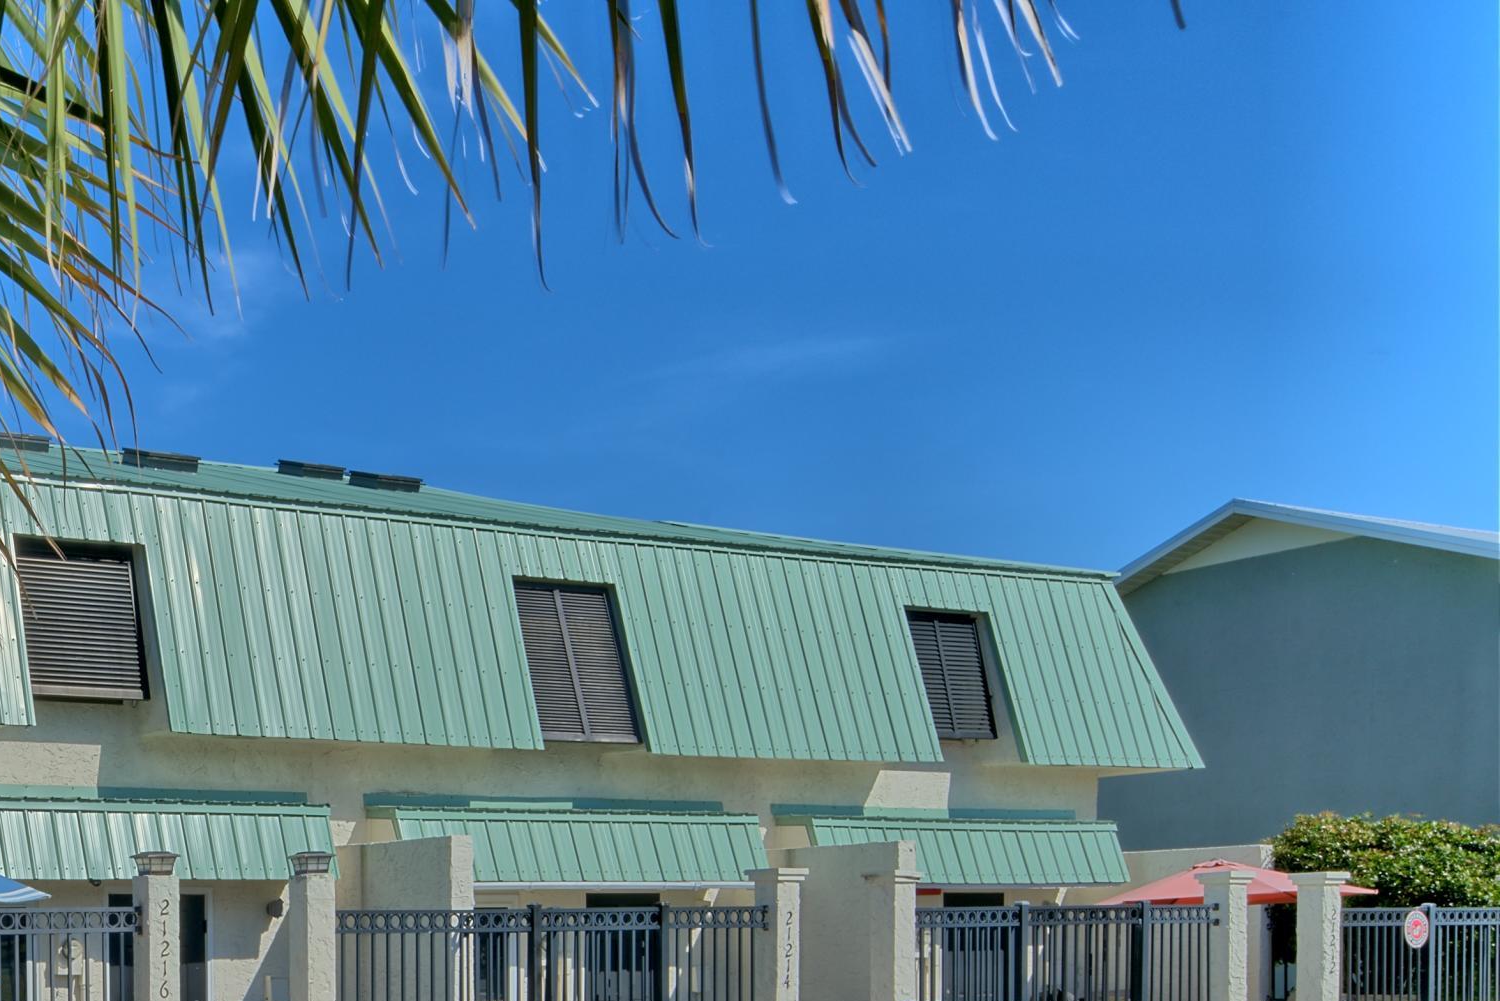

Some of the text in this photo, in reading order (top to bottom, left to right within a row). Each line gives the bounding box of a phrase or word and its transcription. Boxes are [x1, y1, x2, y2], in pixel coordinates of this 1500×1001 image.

[160, 899, 170, 999] 21216
[784, 911, 793, 990] 21214
[1329, 908, 1337, 975] 21212
